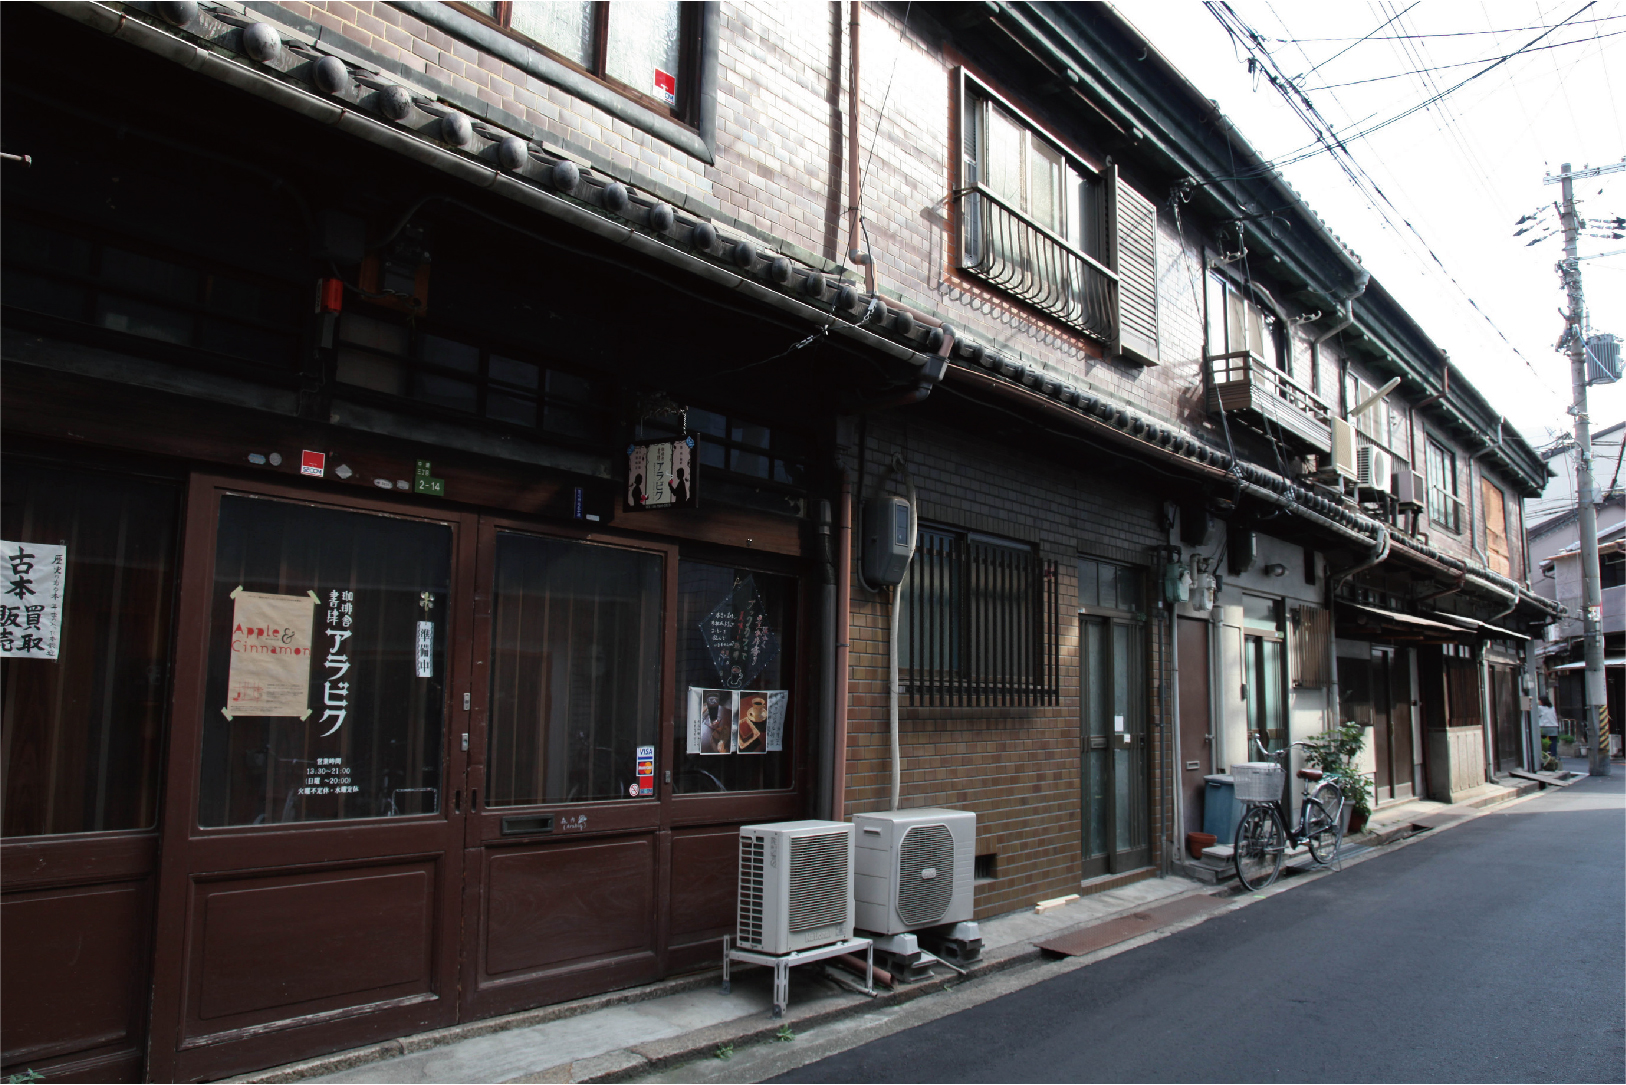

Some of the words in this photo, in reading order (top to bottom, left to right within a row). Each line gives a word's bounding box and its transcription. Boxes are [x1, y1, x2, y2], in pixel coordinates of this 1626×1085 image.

[302, 466, 322, 475] SECOM
[419, 480, 441, 491] 2-14
[655, 462, 664, 502] アラビク
[4, 546, 36, 600] 古本
[16, 605, 45, 653] 買取
[231, 640, 311, 656] Cinnamon
[233, 623, 280, 640] Apple
[281, 627, 295, 644] &
[420, 629, 429, 673] 準備中
[319, 628, 352, 737] アラビク
